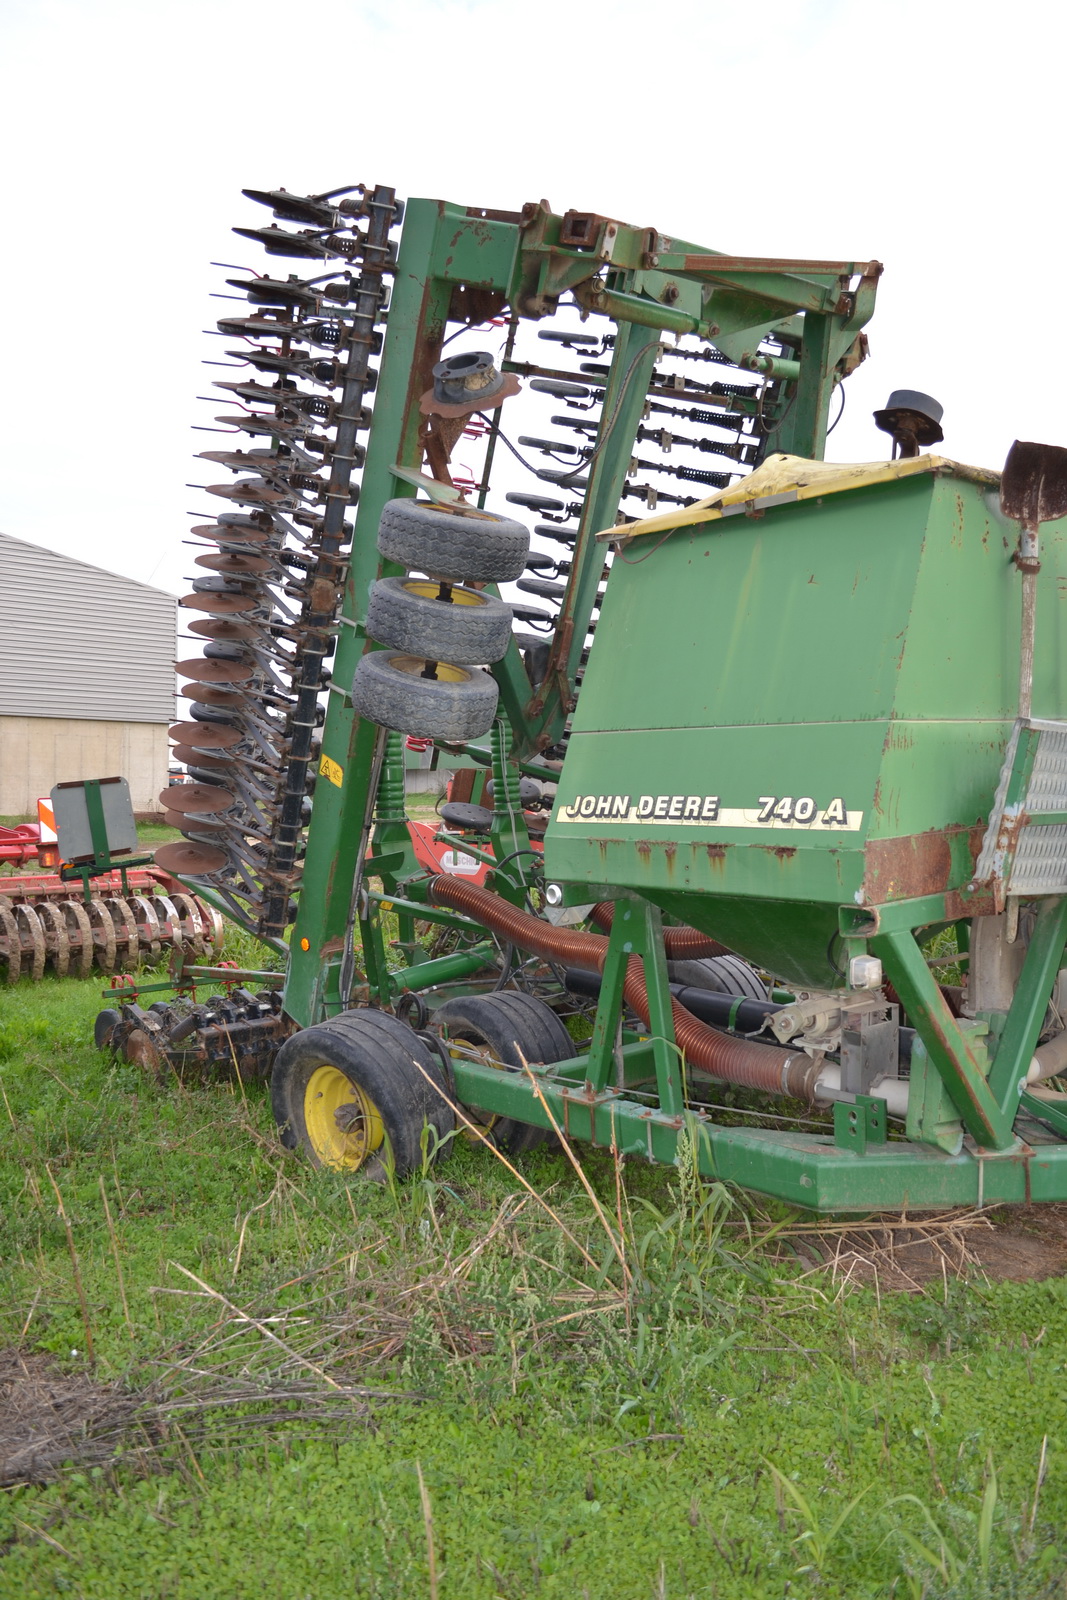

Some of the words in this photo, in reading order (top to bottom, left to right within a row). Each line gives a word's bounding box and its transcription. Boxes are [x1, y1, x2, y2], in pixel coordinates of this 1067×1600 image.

[566, 795, 631, 818] JOHN
[636, 795, 719, 820] DEERE
[757, 796, 817, 824] 740
[821, 797, 847, 825] A
